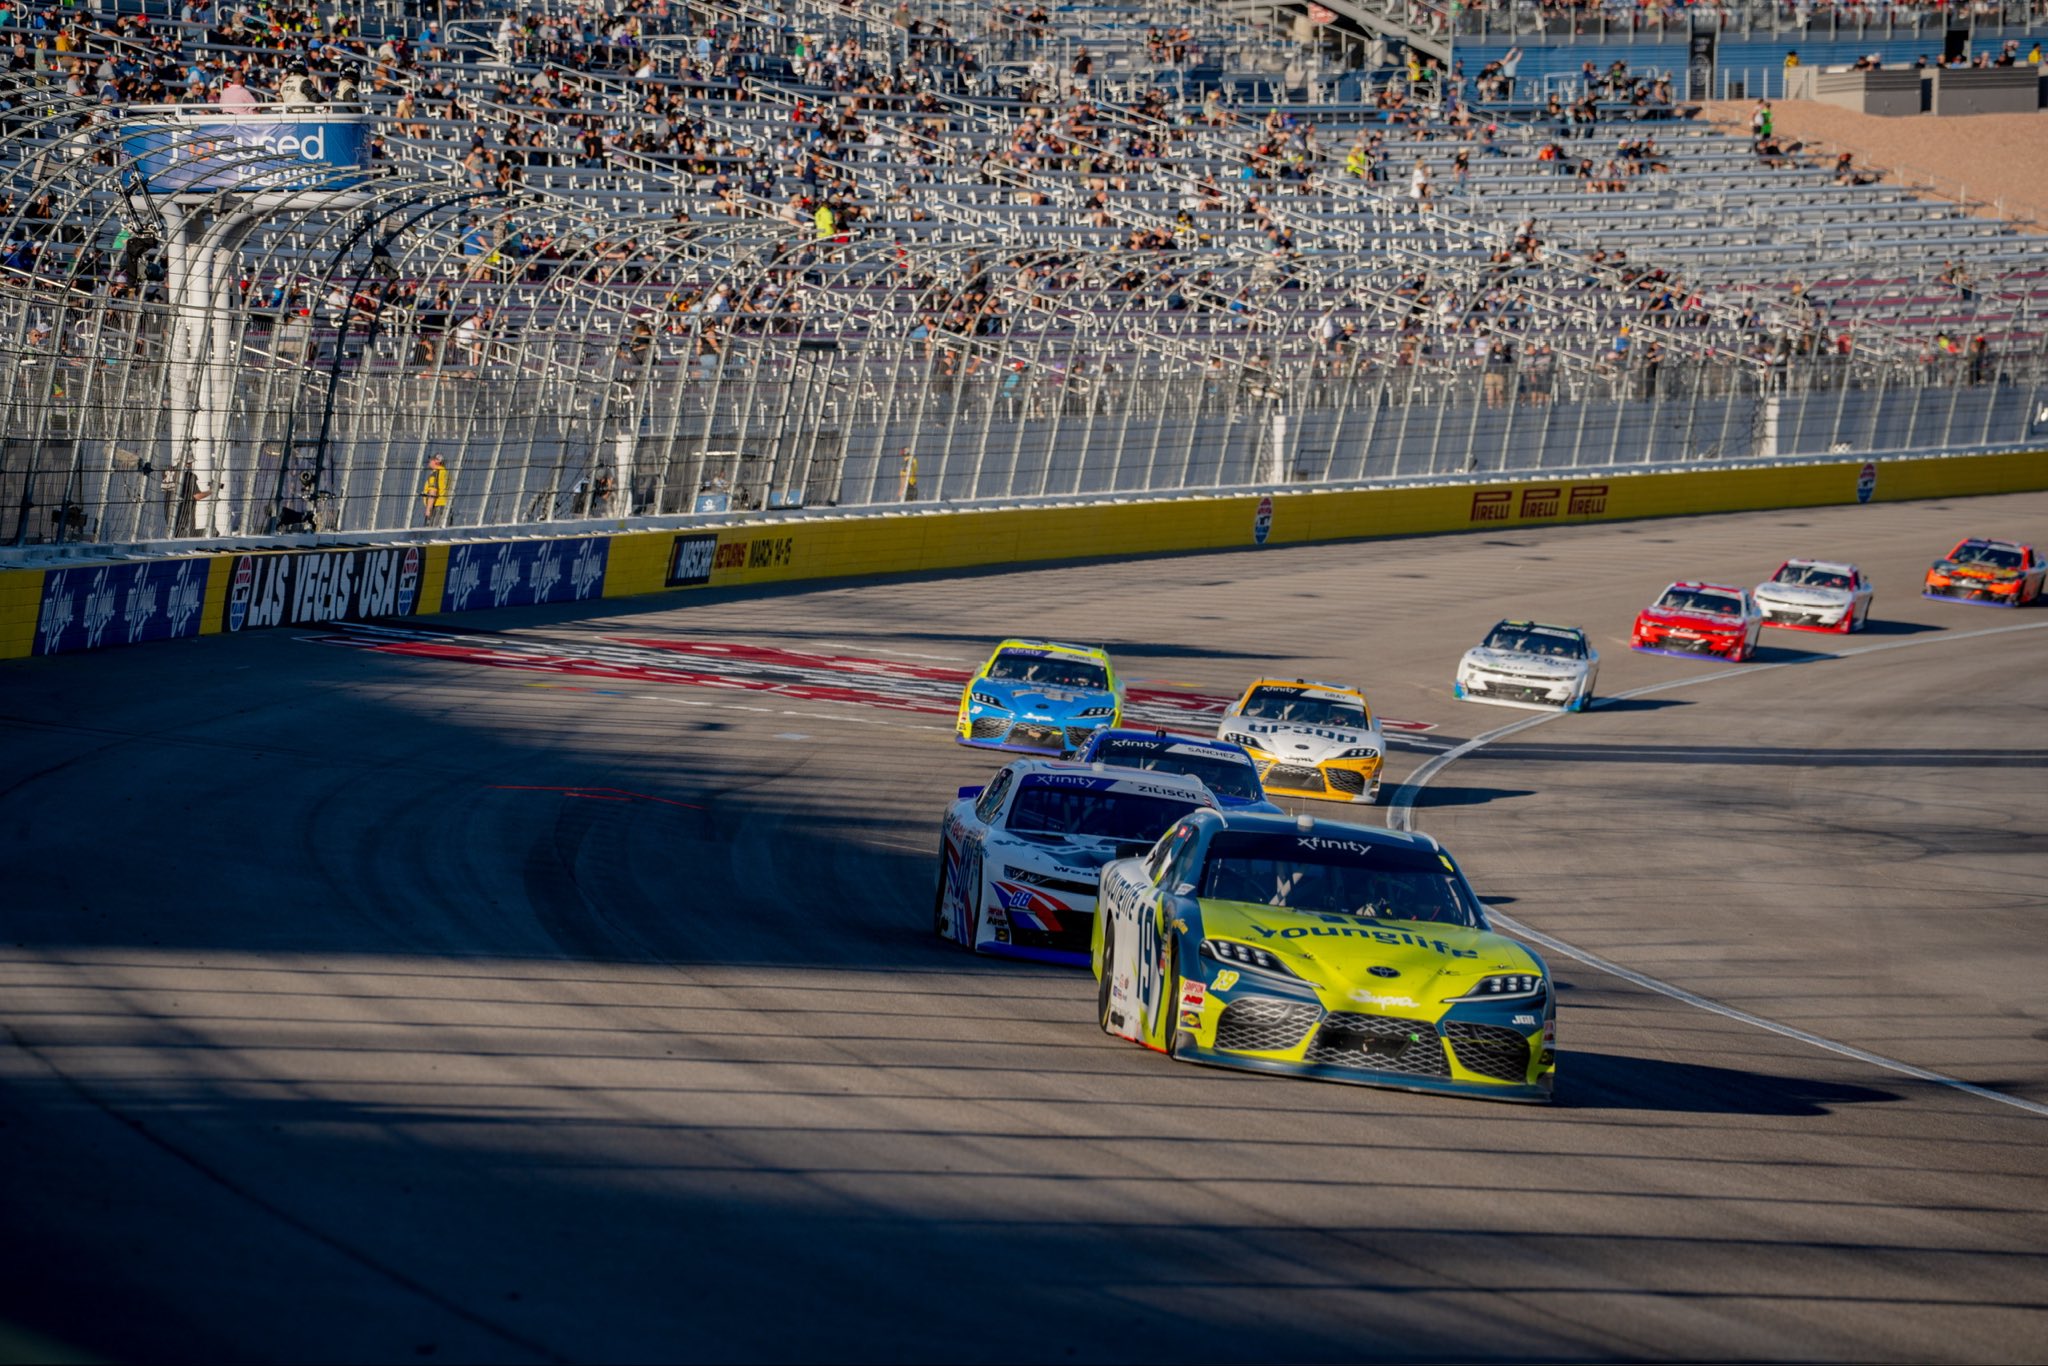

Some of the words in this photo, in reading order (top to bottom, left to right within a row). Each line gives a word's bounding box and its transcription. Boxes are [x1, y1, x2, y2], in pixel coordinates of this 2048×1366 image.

[1471, 491, 1512, 522] PIRELLI
[1520, 488, 1561, 518] PIRELLI
[1568, 485, 1608, 515] PIRELLI
[677, 539, 716, 579] NASCAR
[247, 554, 290, 627] LAS
[1261, 685, 1298, 694] xfinity
[1111, 739, 1160, 750] xfinity
[1187, 747, 1237, 760] SANCHEZ
[1036, 775, 1097, 788] xfinity
[1138, 785, 1197, 800] ZILISCH
[1296, 836, 1372, 856] xfinity
[1008, 891, 1033, 908] 88
[1249, 925, 1478, 959] younglife
[1209, 969, 1240, 992] 19
[1348, 989, 1421, 1010] Supra
[1511, 1014, 1536, 1025] JGR
